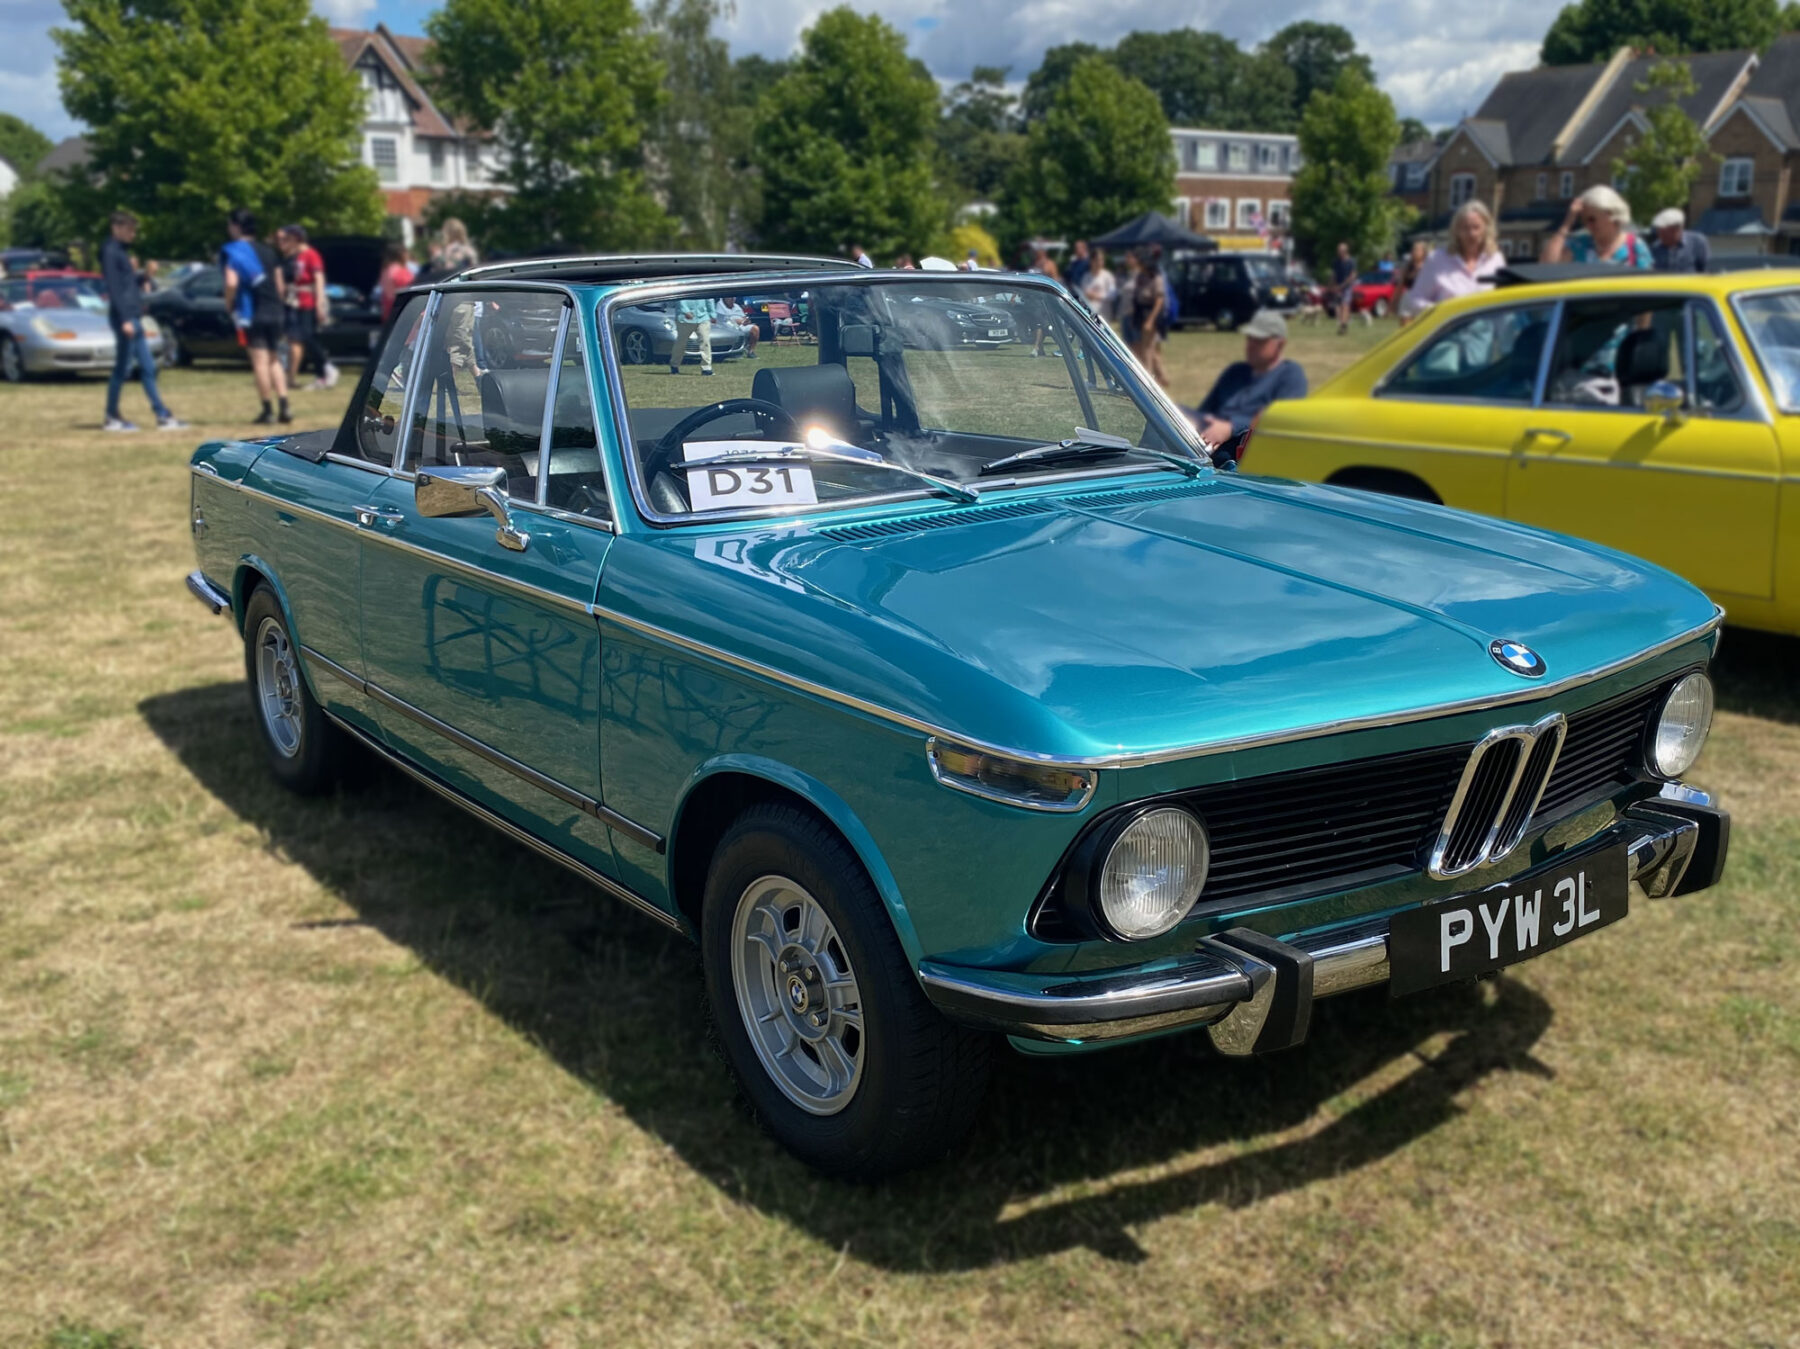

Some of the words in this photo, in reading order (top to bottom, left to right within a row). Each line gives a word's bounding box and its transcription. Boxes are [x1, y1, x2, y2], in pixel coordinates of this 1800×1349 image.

[707, 467, 794, 496] D31
[1440, 889, 1542, 973] PYW
[1552, 871, 1600, 937] 3L
